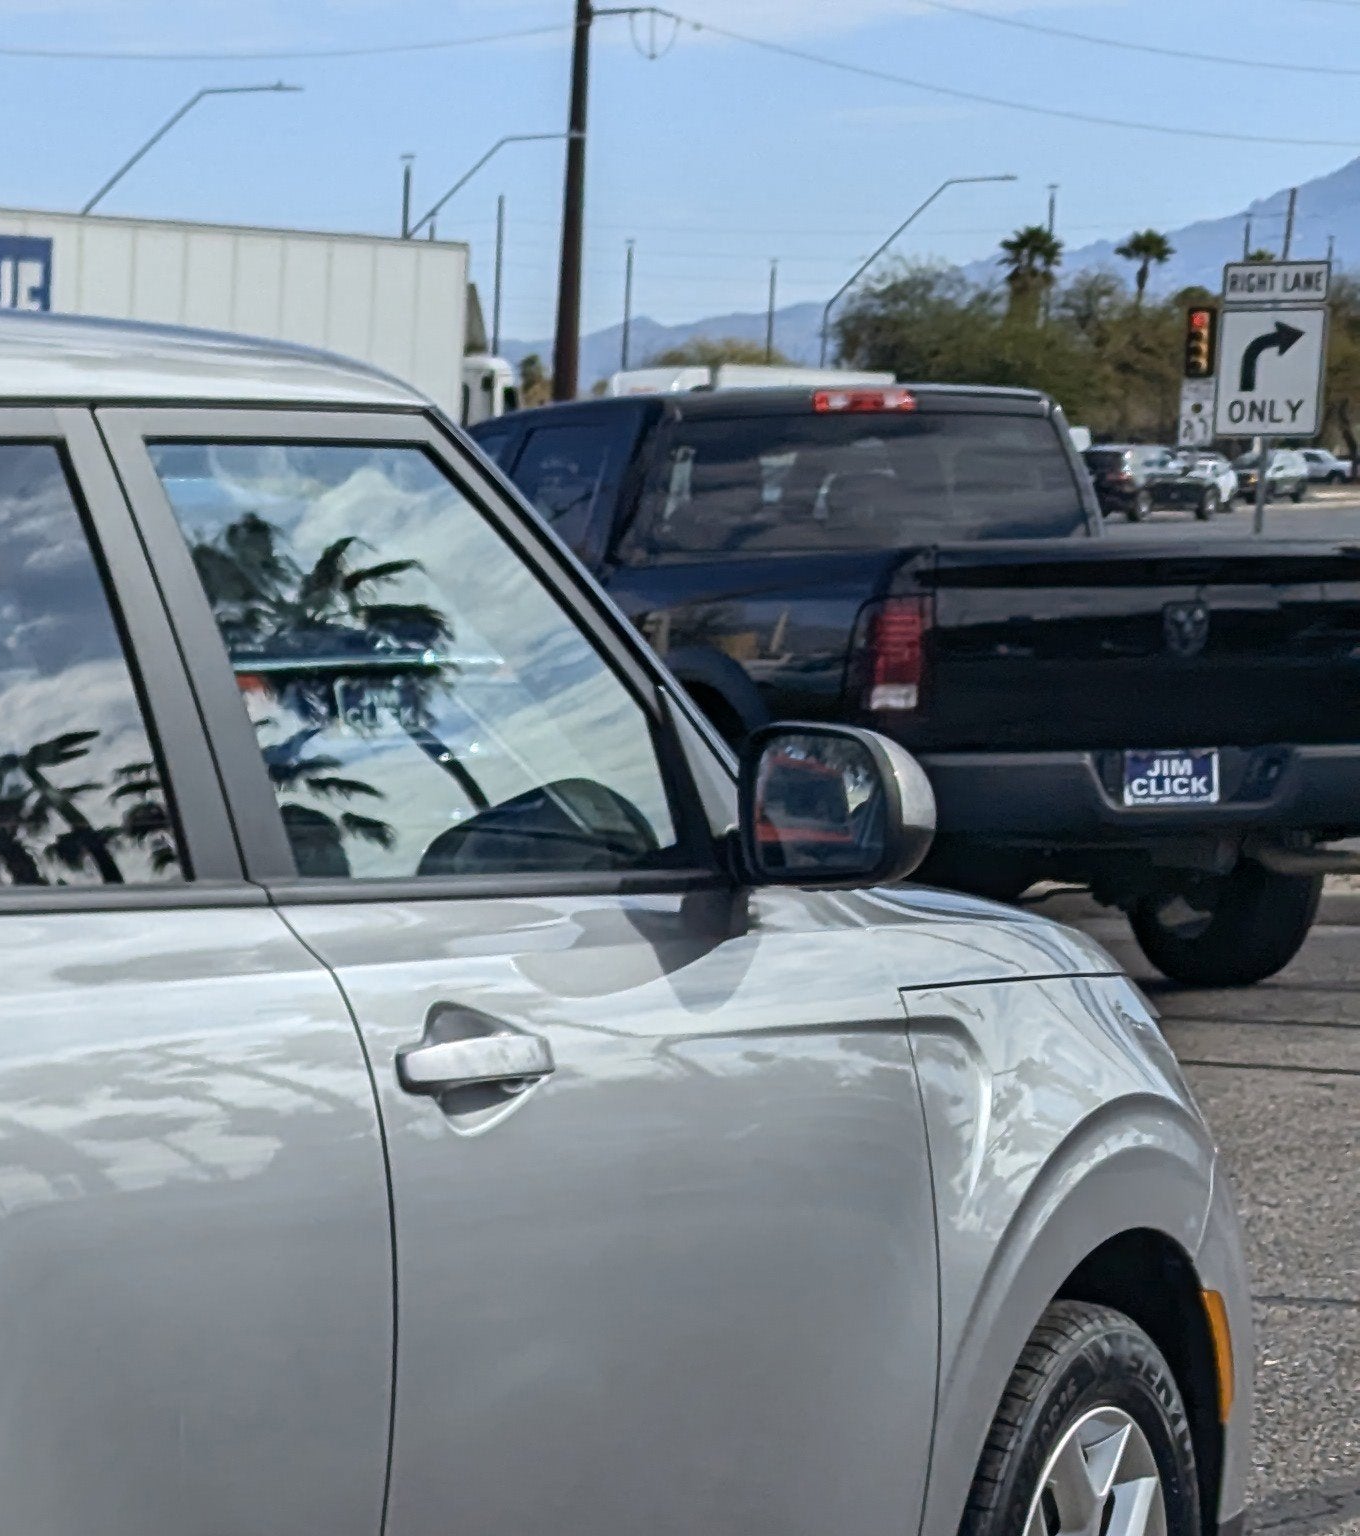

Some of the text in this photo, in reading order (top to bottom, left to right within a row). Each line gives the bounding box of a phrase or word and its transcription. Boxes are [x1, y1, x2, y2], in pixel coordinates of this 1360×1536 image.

[1229, 271, 1323, 293] RIGHT LANE
[1229, 399, 1305, 423] ONLY
[1146, 759, 1193, 776] JIM
[1131, 777, 1208, 795] CLICK
